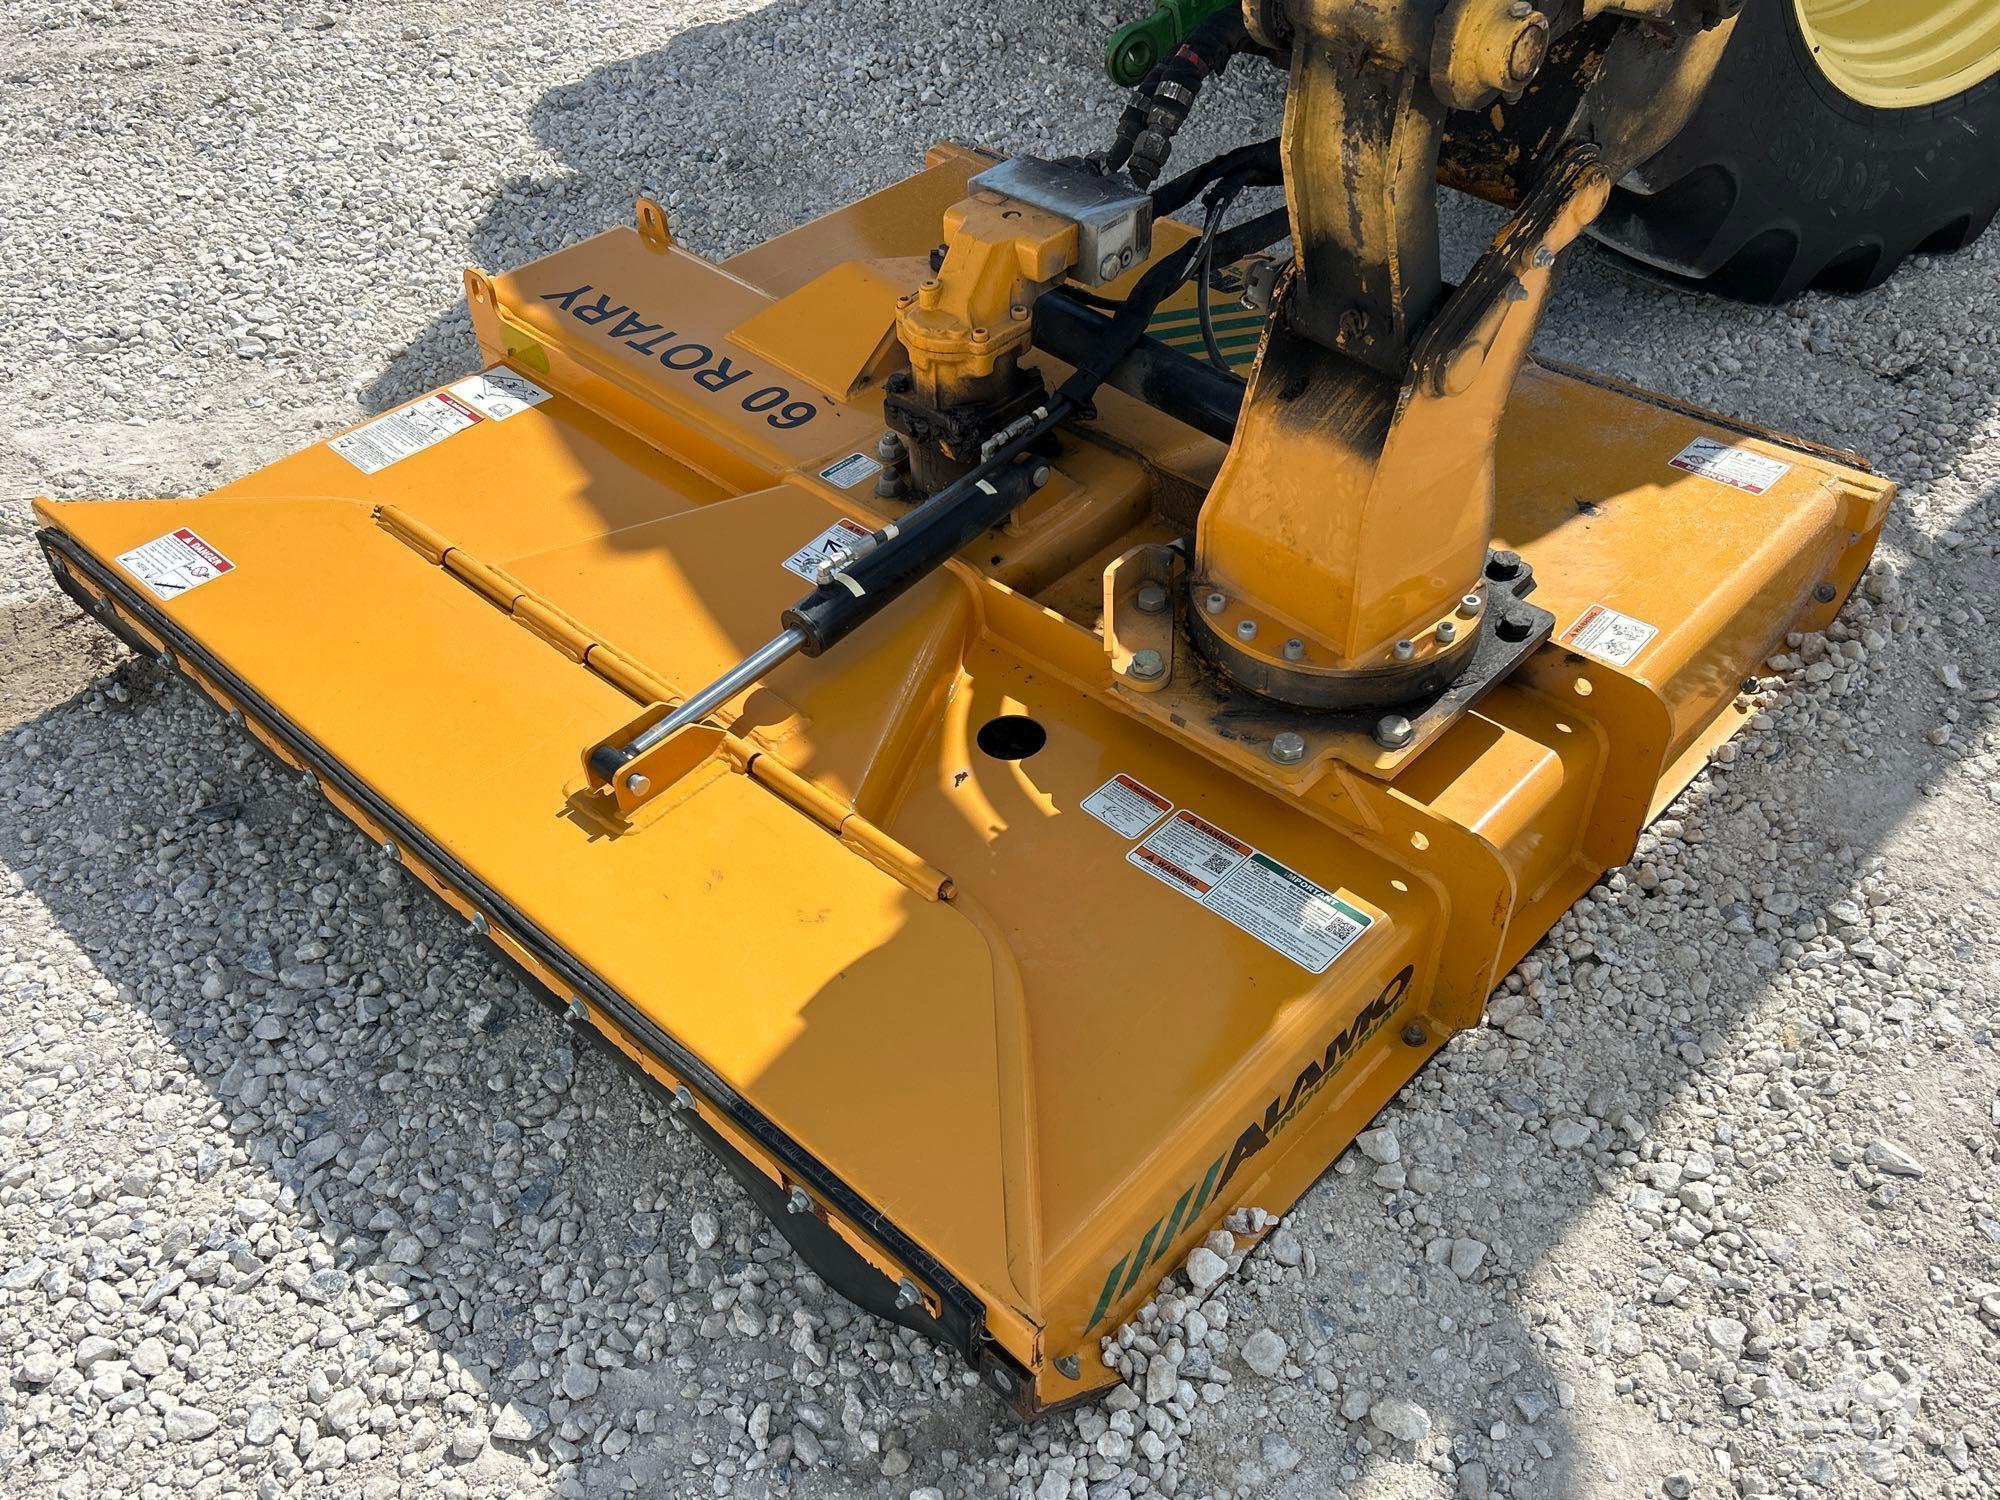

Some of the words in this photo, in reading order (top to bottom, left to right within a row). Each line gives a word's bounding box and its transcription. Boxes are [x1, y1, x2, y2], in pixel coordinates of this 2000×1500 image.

[540, 284, 753, 392] ROTARY
[741, 386, 817, 429] 60
[1685, 464, 1732, 482] DANGER
[191, 542, 222, 566] DANGER
[1573, 611, 1597, 632] WARNING
[1198, 823, 1241, 850] WARNING
[1154, 859, 1200, 886] WARNING
[1283, 871, 1339, 906] IMPORTANT
[1272, 998, 1405, 1138] INDUSTRIAL
[1210, 964, 1414, 1204] ALAMO
